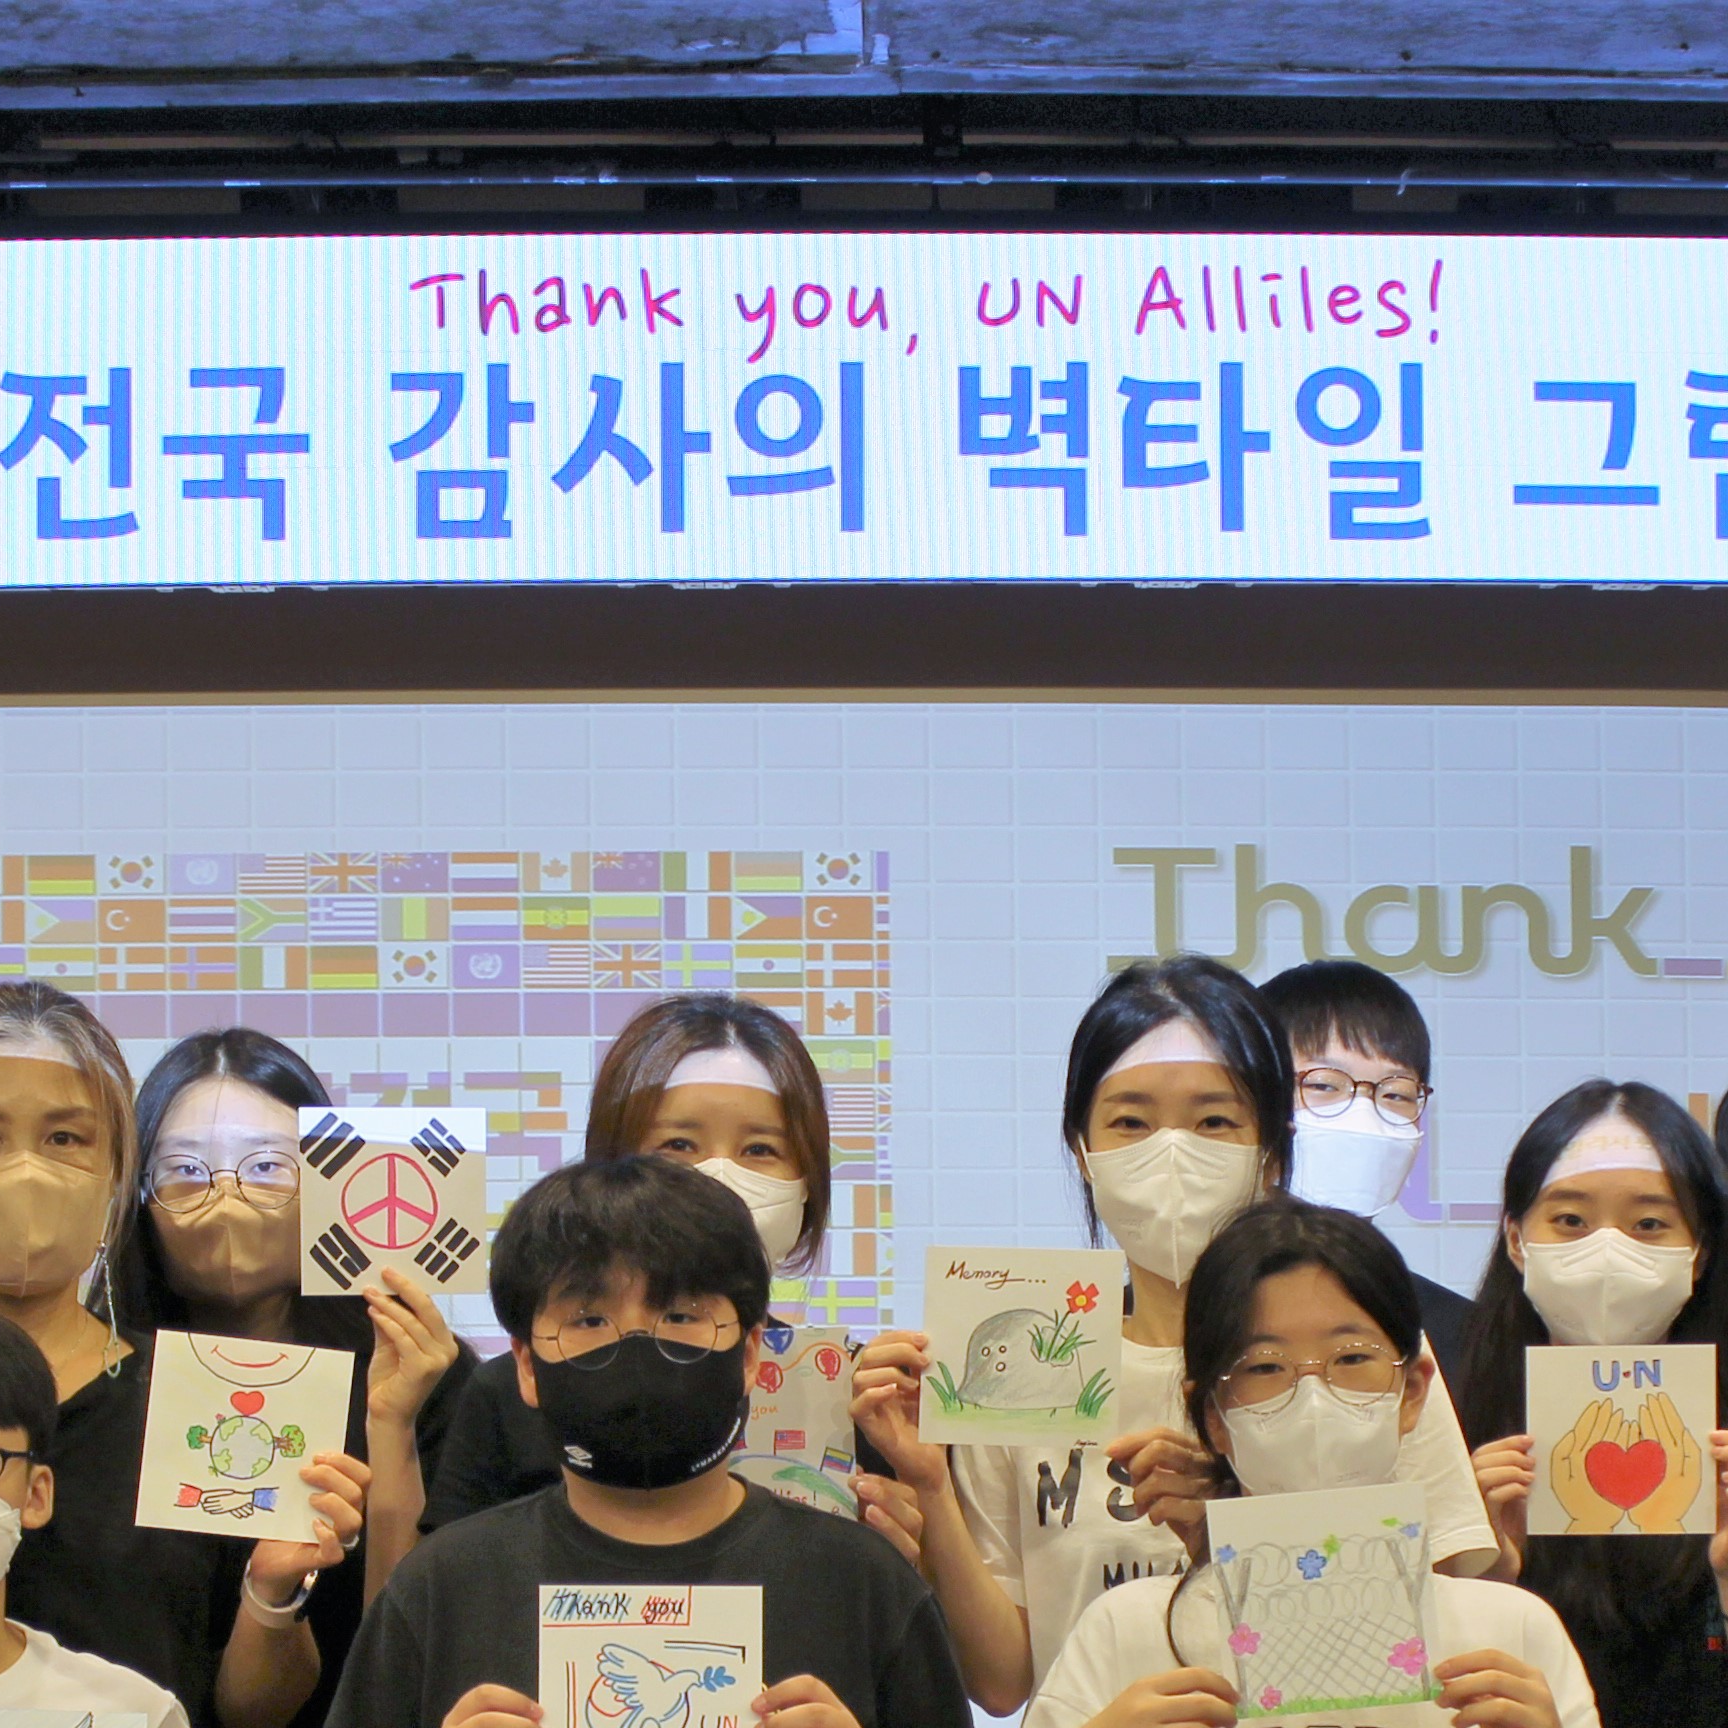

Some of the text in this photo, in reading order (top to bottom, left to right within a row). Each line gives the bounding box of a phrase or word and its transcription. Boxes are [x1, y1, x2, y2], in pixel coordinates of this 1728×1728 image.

[410, 268, 683, 334] Thank
[734, 283, 918, 364] you,
[976, 275, 1083, 326] UN
[387, 361, 865, 539] 감사의
[958, 360, 1431, 540] 벽타일
[643, 1597, 685, 1624] you
